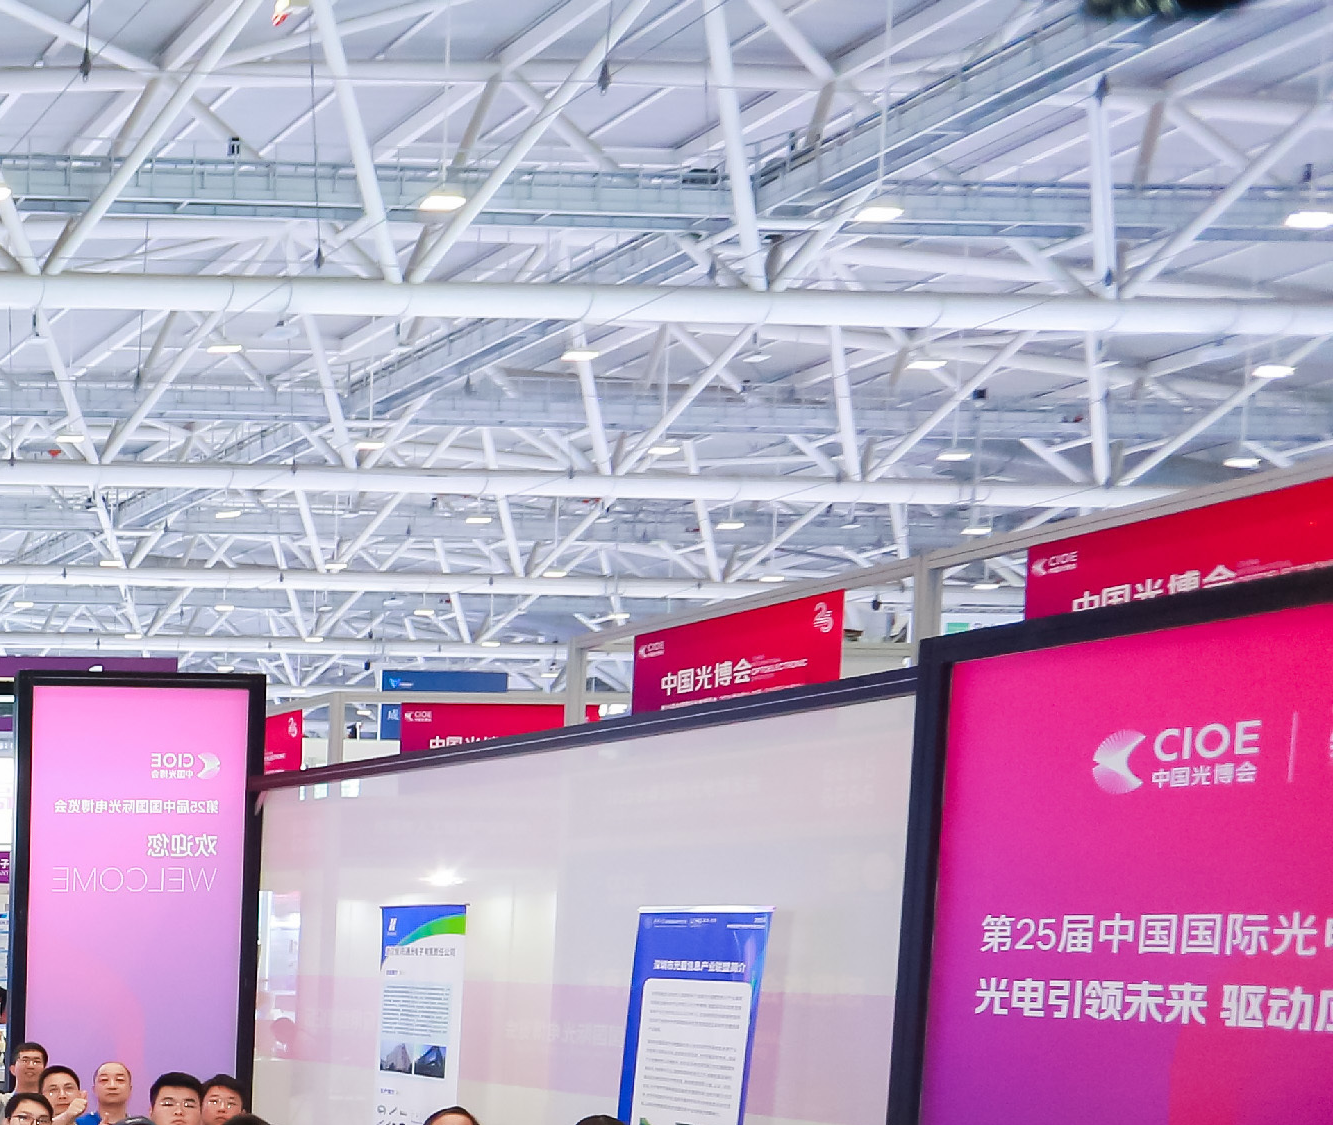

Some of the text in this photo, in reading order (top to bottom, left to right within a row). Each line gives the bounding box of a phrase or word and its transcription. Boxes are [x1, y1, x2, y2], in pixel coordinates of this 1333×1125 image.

[660, 658, 752, 696] 中国光博会
[1152, 720, 1262, 762] CIOE
[1151, 761, 1258, 788] 中国光博会
[974, 978, 1208, 1025] 光电引领未来
